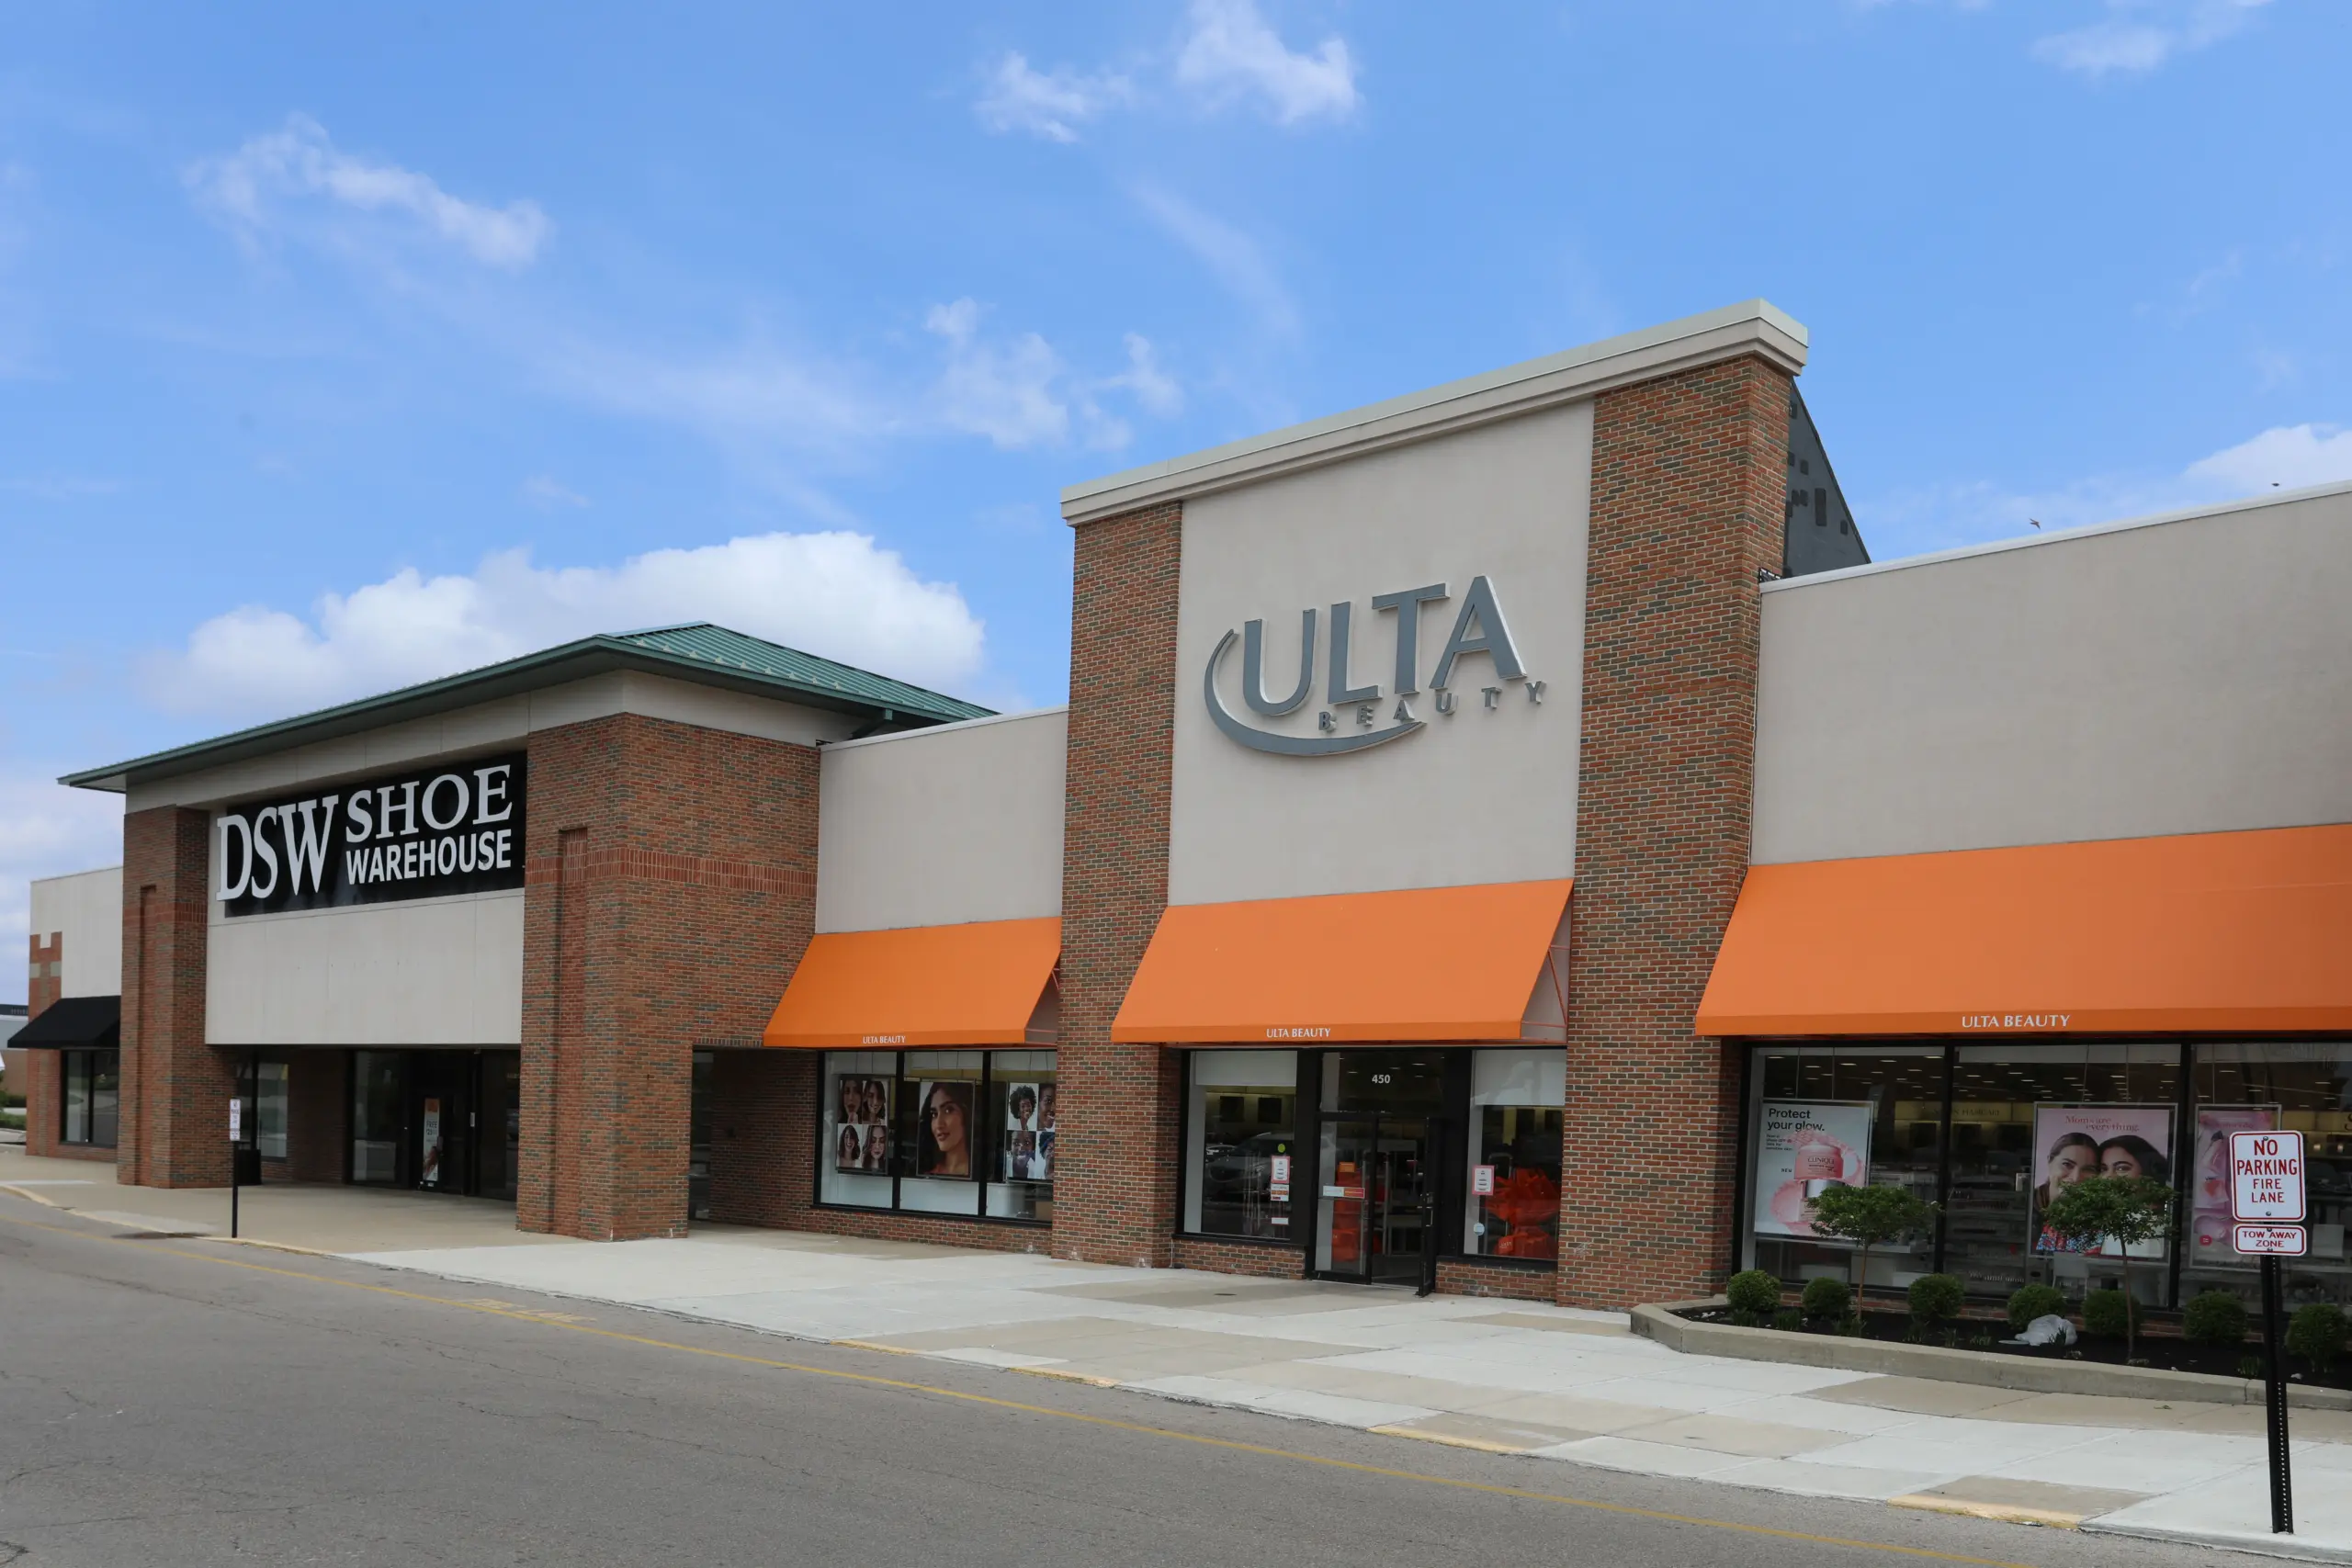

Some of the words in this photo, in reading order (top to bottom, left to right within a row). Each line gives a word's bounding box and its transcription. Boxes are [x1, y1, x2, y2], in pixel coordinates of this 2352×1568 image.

[1242, 575, 1528, 716] ULTA
[1318, 680, 1547, 732] BEAUTY
[345, 764, 513, 843] SHOE
[216, 795, 340, 902] DSW
[345, 829, 512, 886] WAREHOUSE
[1962, 1015, 1999, 1028] ULTA
[2004, 1014, 2070, 1027] BEAUTY
[1266, 1029, 1290, 1038] ULTA
[1292, 1028, 1331, 1038] BEAUTY
[863, 1036, 878, 1044] ULTA
[879, 1035, 906, 1043] BEAUTY
[1372, 1074, 1391, 1084] 450
[1769, 1108, 1811, 1119] Protect
[1768, 1121, 1792, 1131] your
[1794, 1121, 1826, 1132] glow.
[2254, 1139, 2278, 1156] NO
[2236, 1158, 2298, 1176] PARKING
[2254, 1179, 2282, 1190] FIRE
[2252, 1191, 2285, 1203] LANE
[2243, 1230, 2266, 1239] TOW
[2269, 1231, 2297, 1240] AWAY
[2256, 1239, 2285, 1248] ZONE
